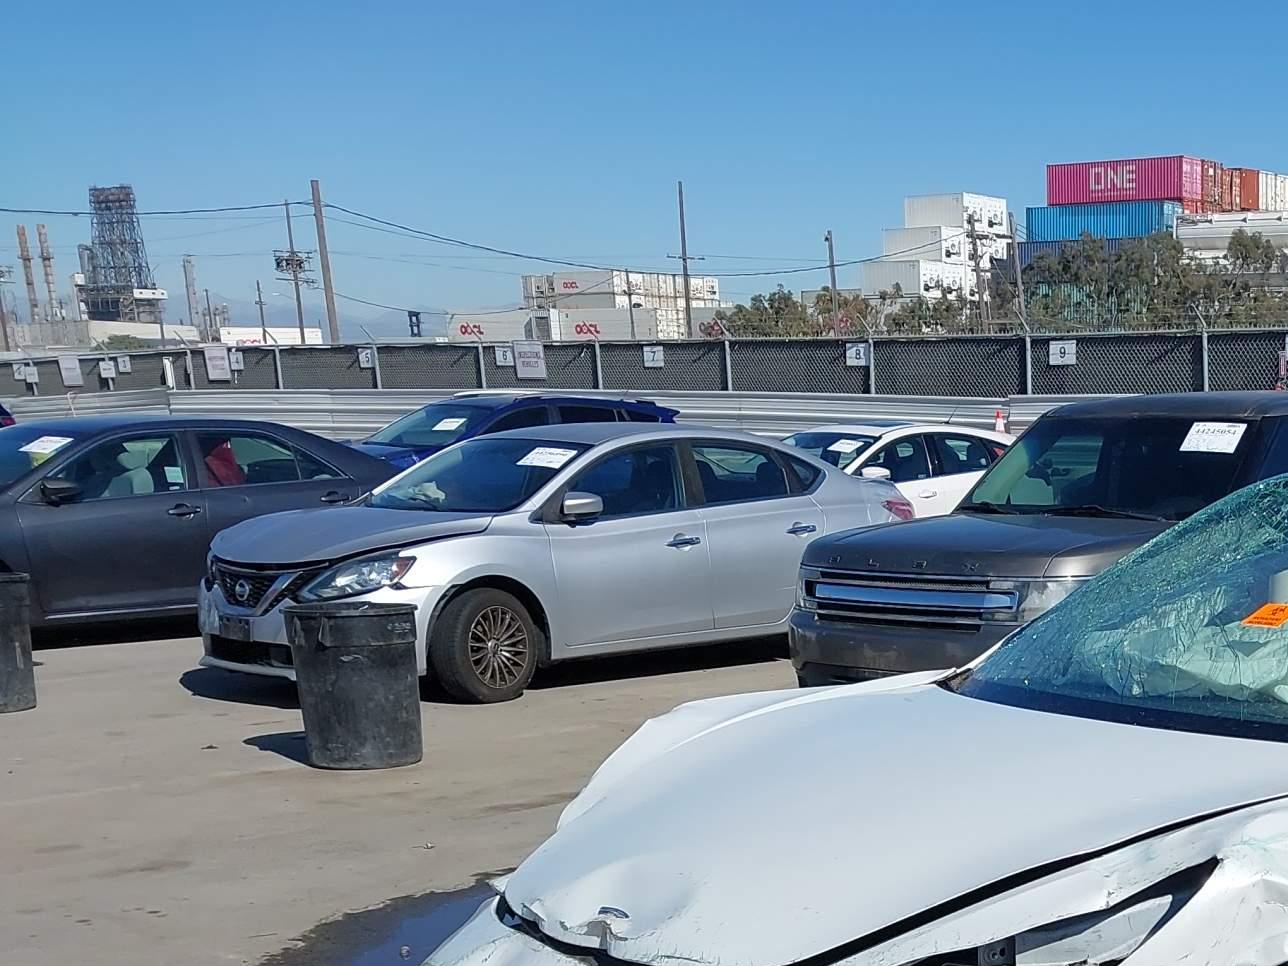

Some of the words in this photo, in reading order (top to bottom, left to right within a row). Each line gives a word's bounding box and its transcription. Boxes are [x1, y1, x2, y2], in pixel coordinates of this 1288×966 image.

[1090, 165, 1136, 191] ONE
[502, 350, 508, 361] 6
[650, 350, 657, 361] 7
[855, 348, 862, 360] 8
[1059, 346, 1066, 359] 9
